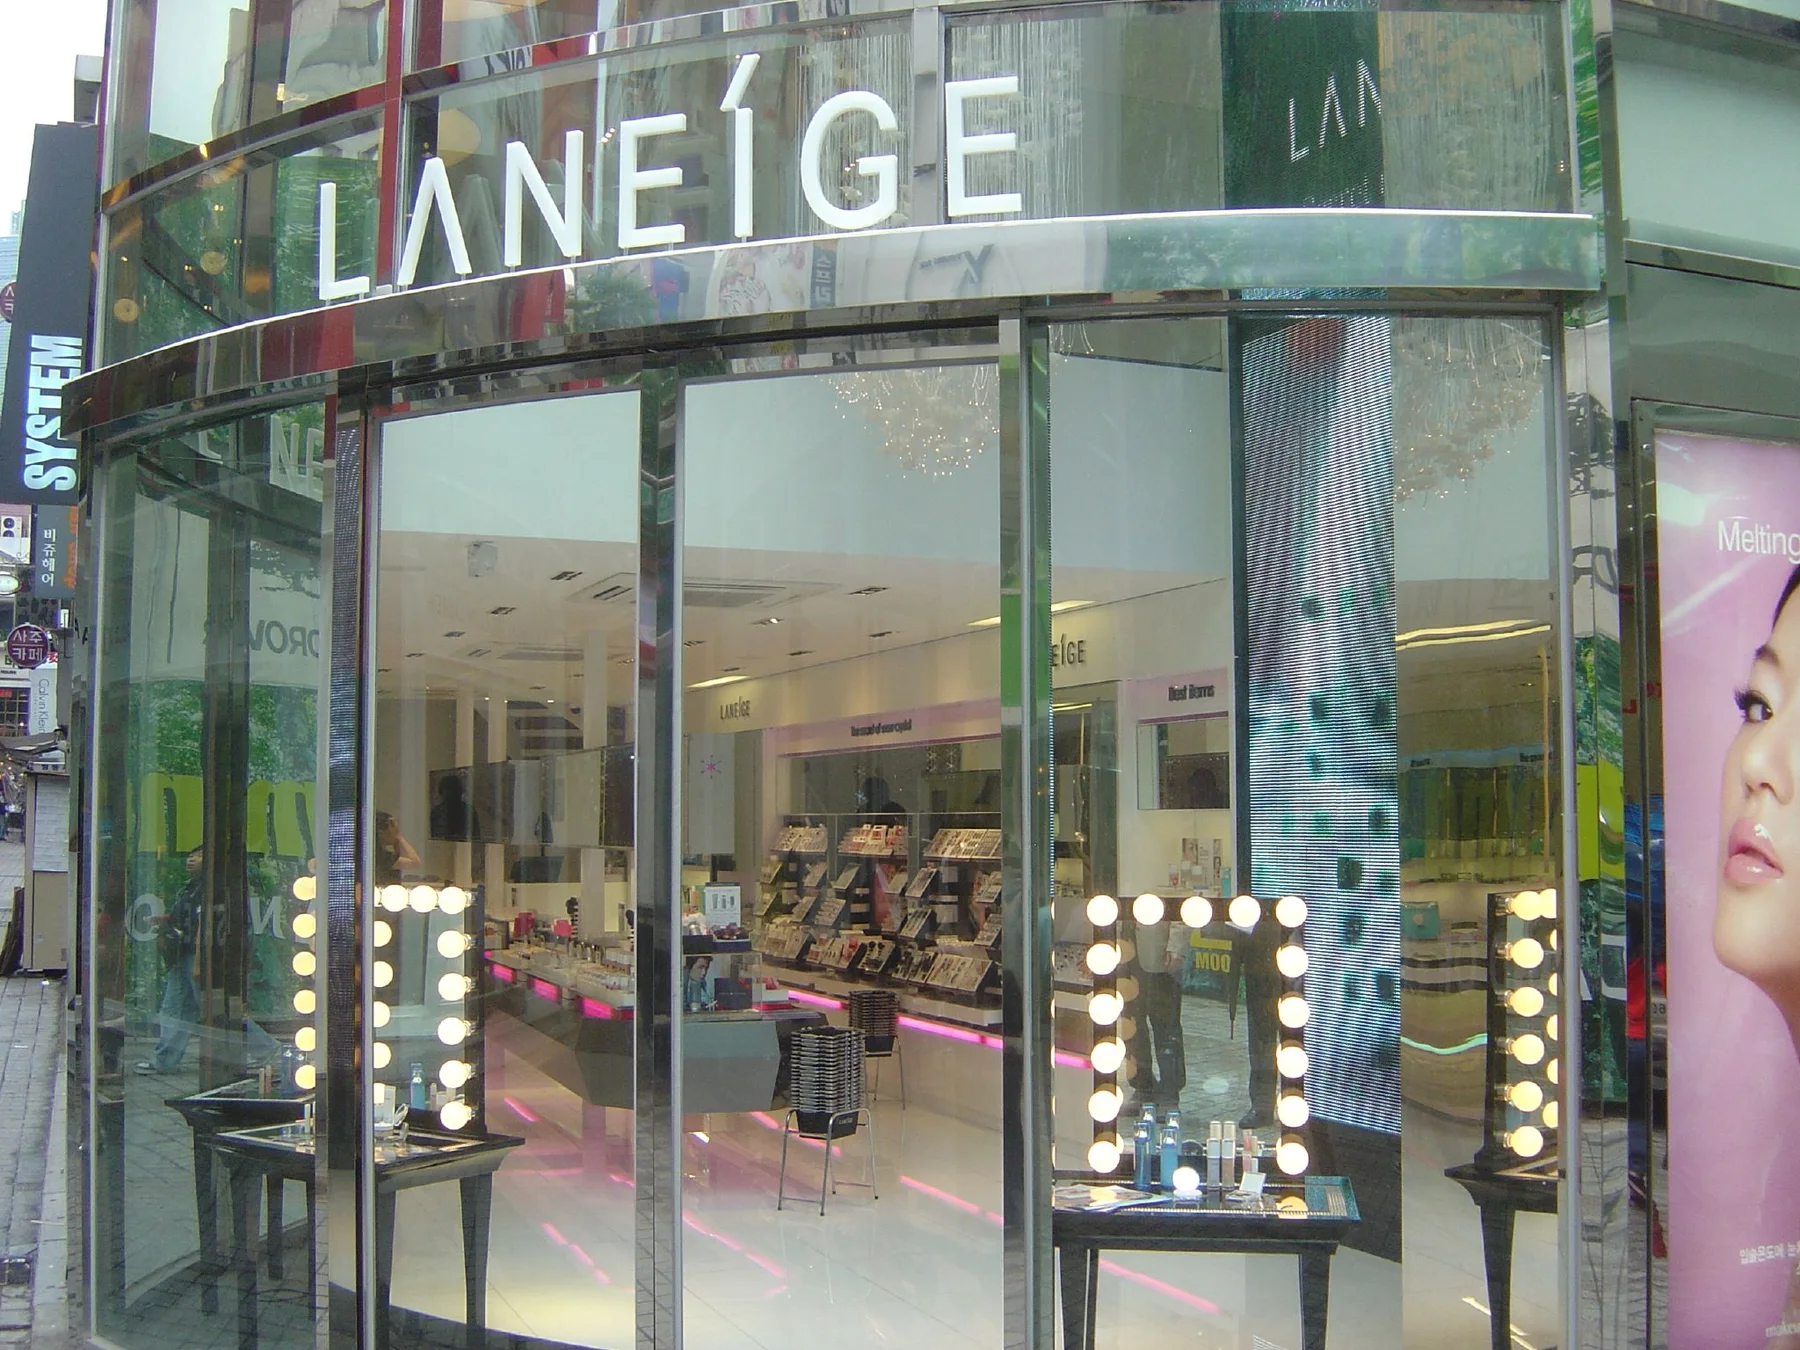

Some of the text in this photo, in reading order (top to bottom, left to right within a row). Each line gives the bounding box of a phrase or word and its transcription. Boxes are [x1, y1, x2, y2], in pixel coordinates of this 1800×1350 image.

[24, 334, 82, 492] SYSTEM
[41, 528, 56, 587] 비쥬헤어
[1718, 520, 1800, 564] Melting
[12, 630, 43, 644] 사주
[12, 647, 43, 661] 카페
[38, 678, 50, 710] Calvin
